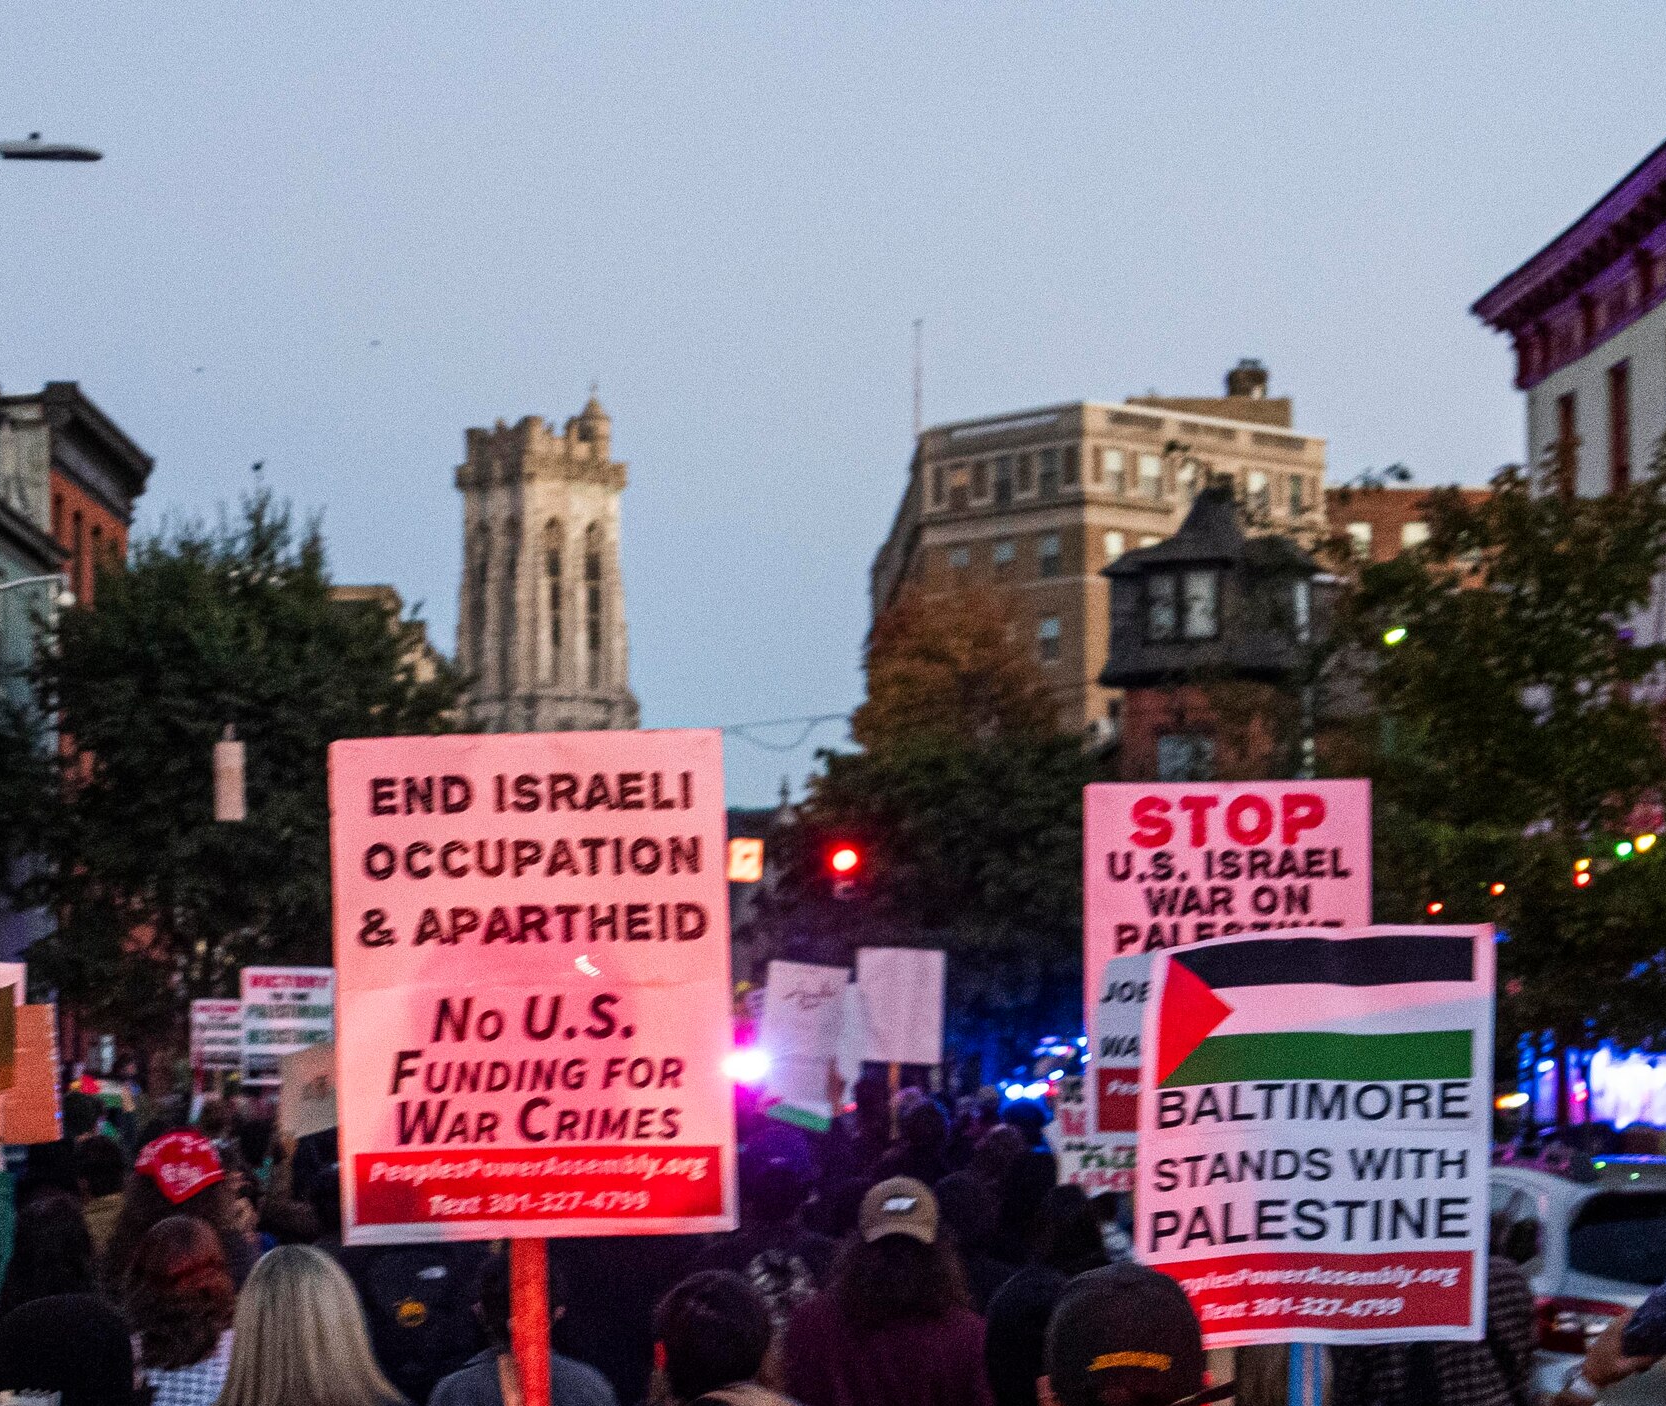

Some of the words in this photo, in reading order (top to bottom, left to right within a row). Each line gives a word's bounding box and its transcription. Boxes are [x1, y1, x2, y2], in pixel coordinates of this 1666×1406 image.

[370, 774, 471, 816] END
[493, 769, 694, 815] ISRAELI
[1129, 792, 1328, 849] STOP
[363, 836, 702, 881] OCCUPATION
[1106, 849, 1191, 883] U.S.
[1203, 847, 1354, 882] ISRAEL
[1142, 884, 1236, 918] WAR
[1251, 883, 1312, 916] ON
[356, 907, 397, 948] &
[410, 902, 711, 946] APARTHEID
[522, 991, 639, 1042] U.S.
[1154, 1081, 1472, 1130] BALTIMORE
[367, 1153, 710, 1188] PeoplesPowerAssembly.org
[1152, 1147, 1335, 1194] STANDS
[1347, 1147, 1471, 1182] WITH
[427, 1193, 480, 1217] Text
[486, 1190, 651, 1215] 301-327-4799
[1147, 1196, 1472, 1254] PALESTINE
[1199, 1301, 1250, 1322] Text
[1251, 1296, 1405, 1318] 301-327-4799
